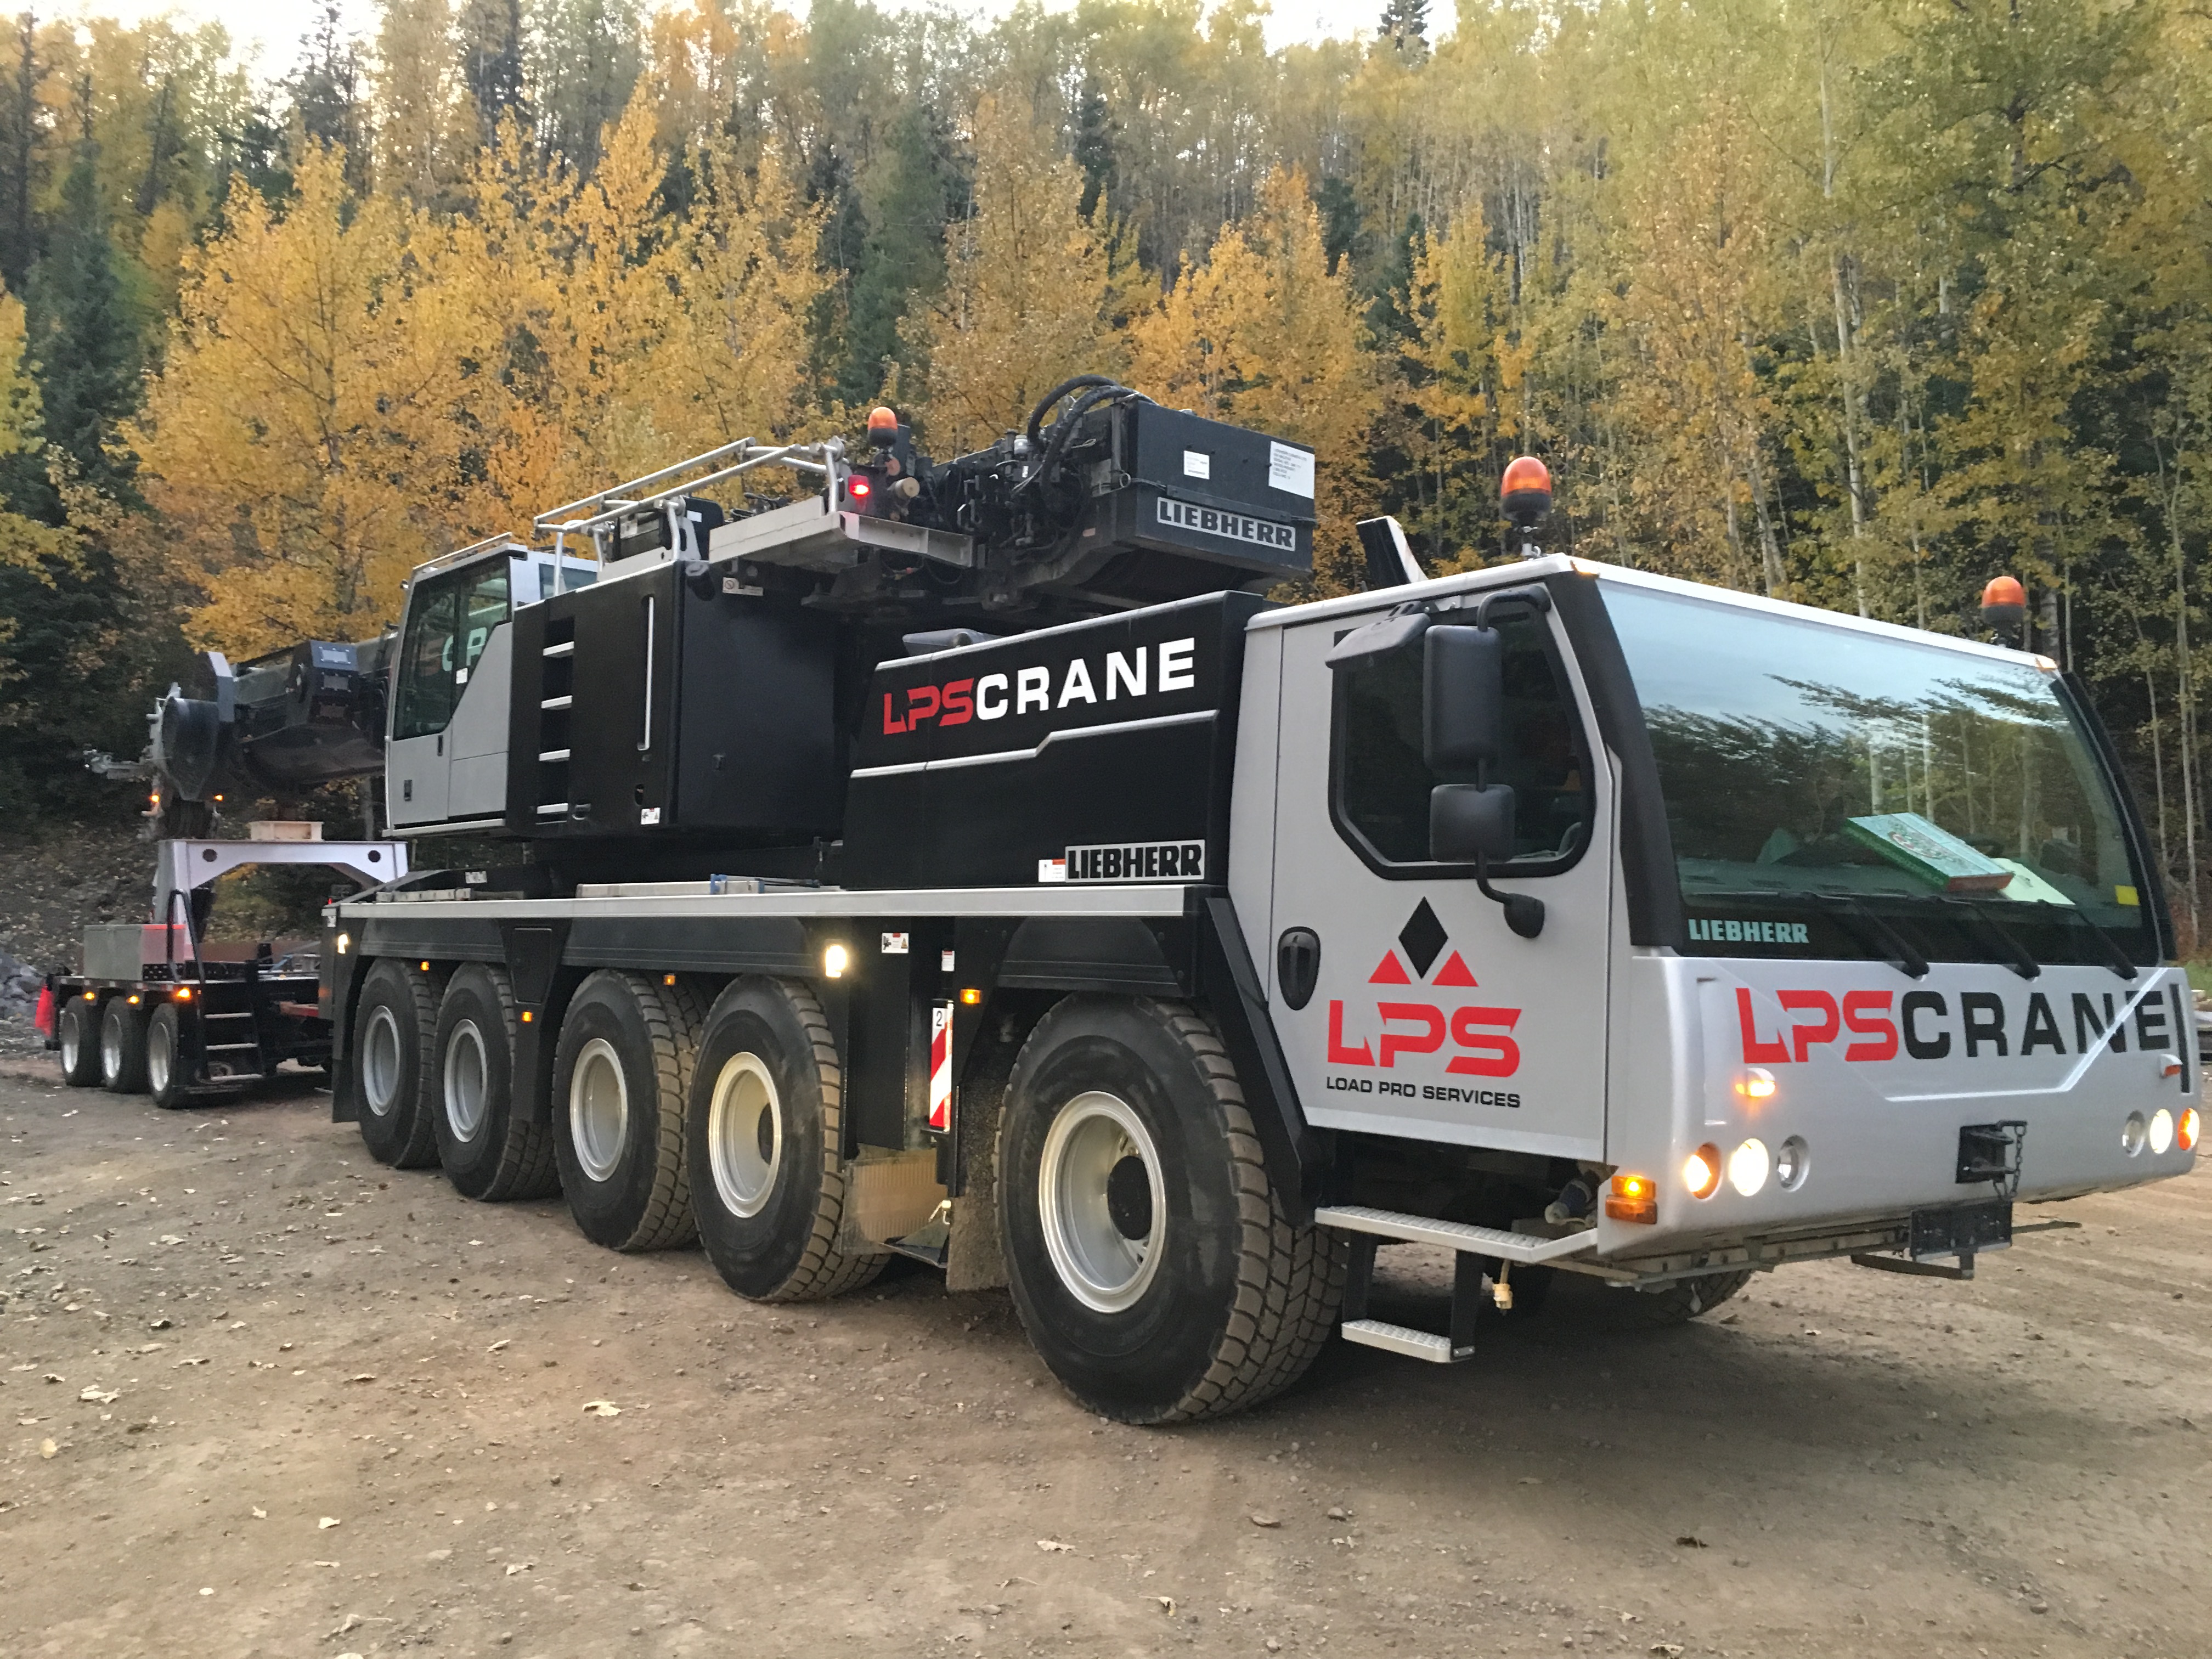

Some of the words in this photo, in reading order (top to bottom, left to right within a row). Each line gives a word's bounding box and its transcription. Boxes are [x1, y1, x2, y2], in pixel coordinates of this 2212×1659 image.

[1159, 500, 1293, 548] LIEBHERR
[1067, 844, 1202, 880] LIEBHERR
[1688, 918, 1809, 944] LIEBHERR
[935, 1010, 943, 1027] 2
[1327, 999, 1522, 1078] LPS
[1326, 1076, 1373, 1094] LOAD
[1378, 1080, 1417, 1098] PRO
[1422, 1085, 1521, 1109] SERVICES
